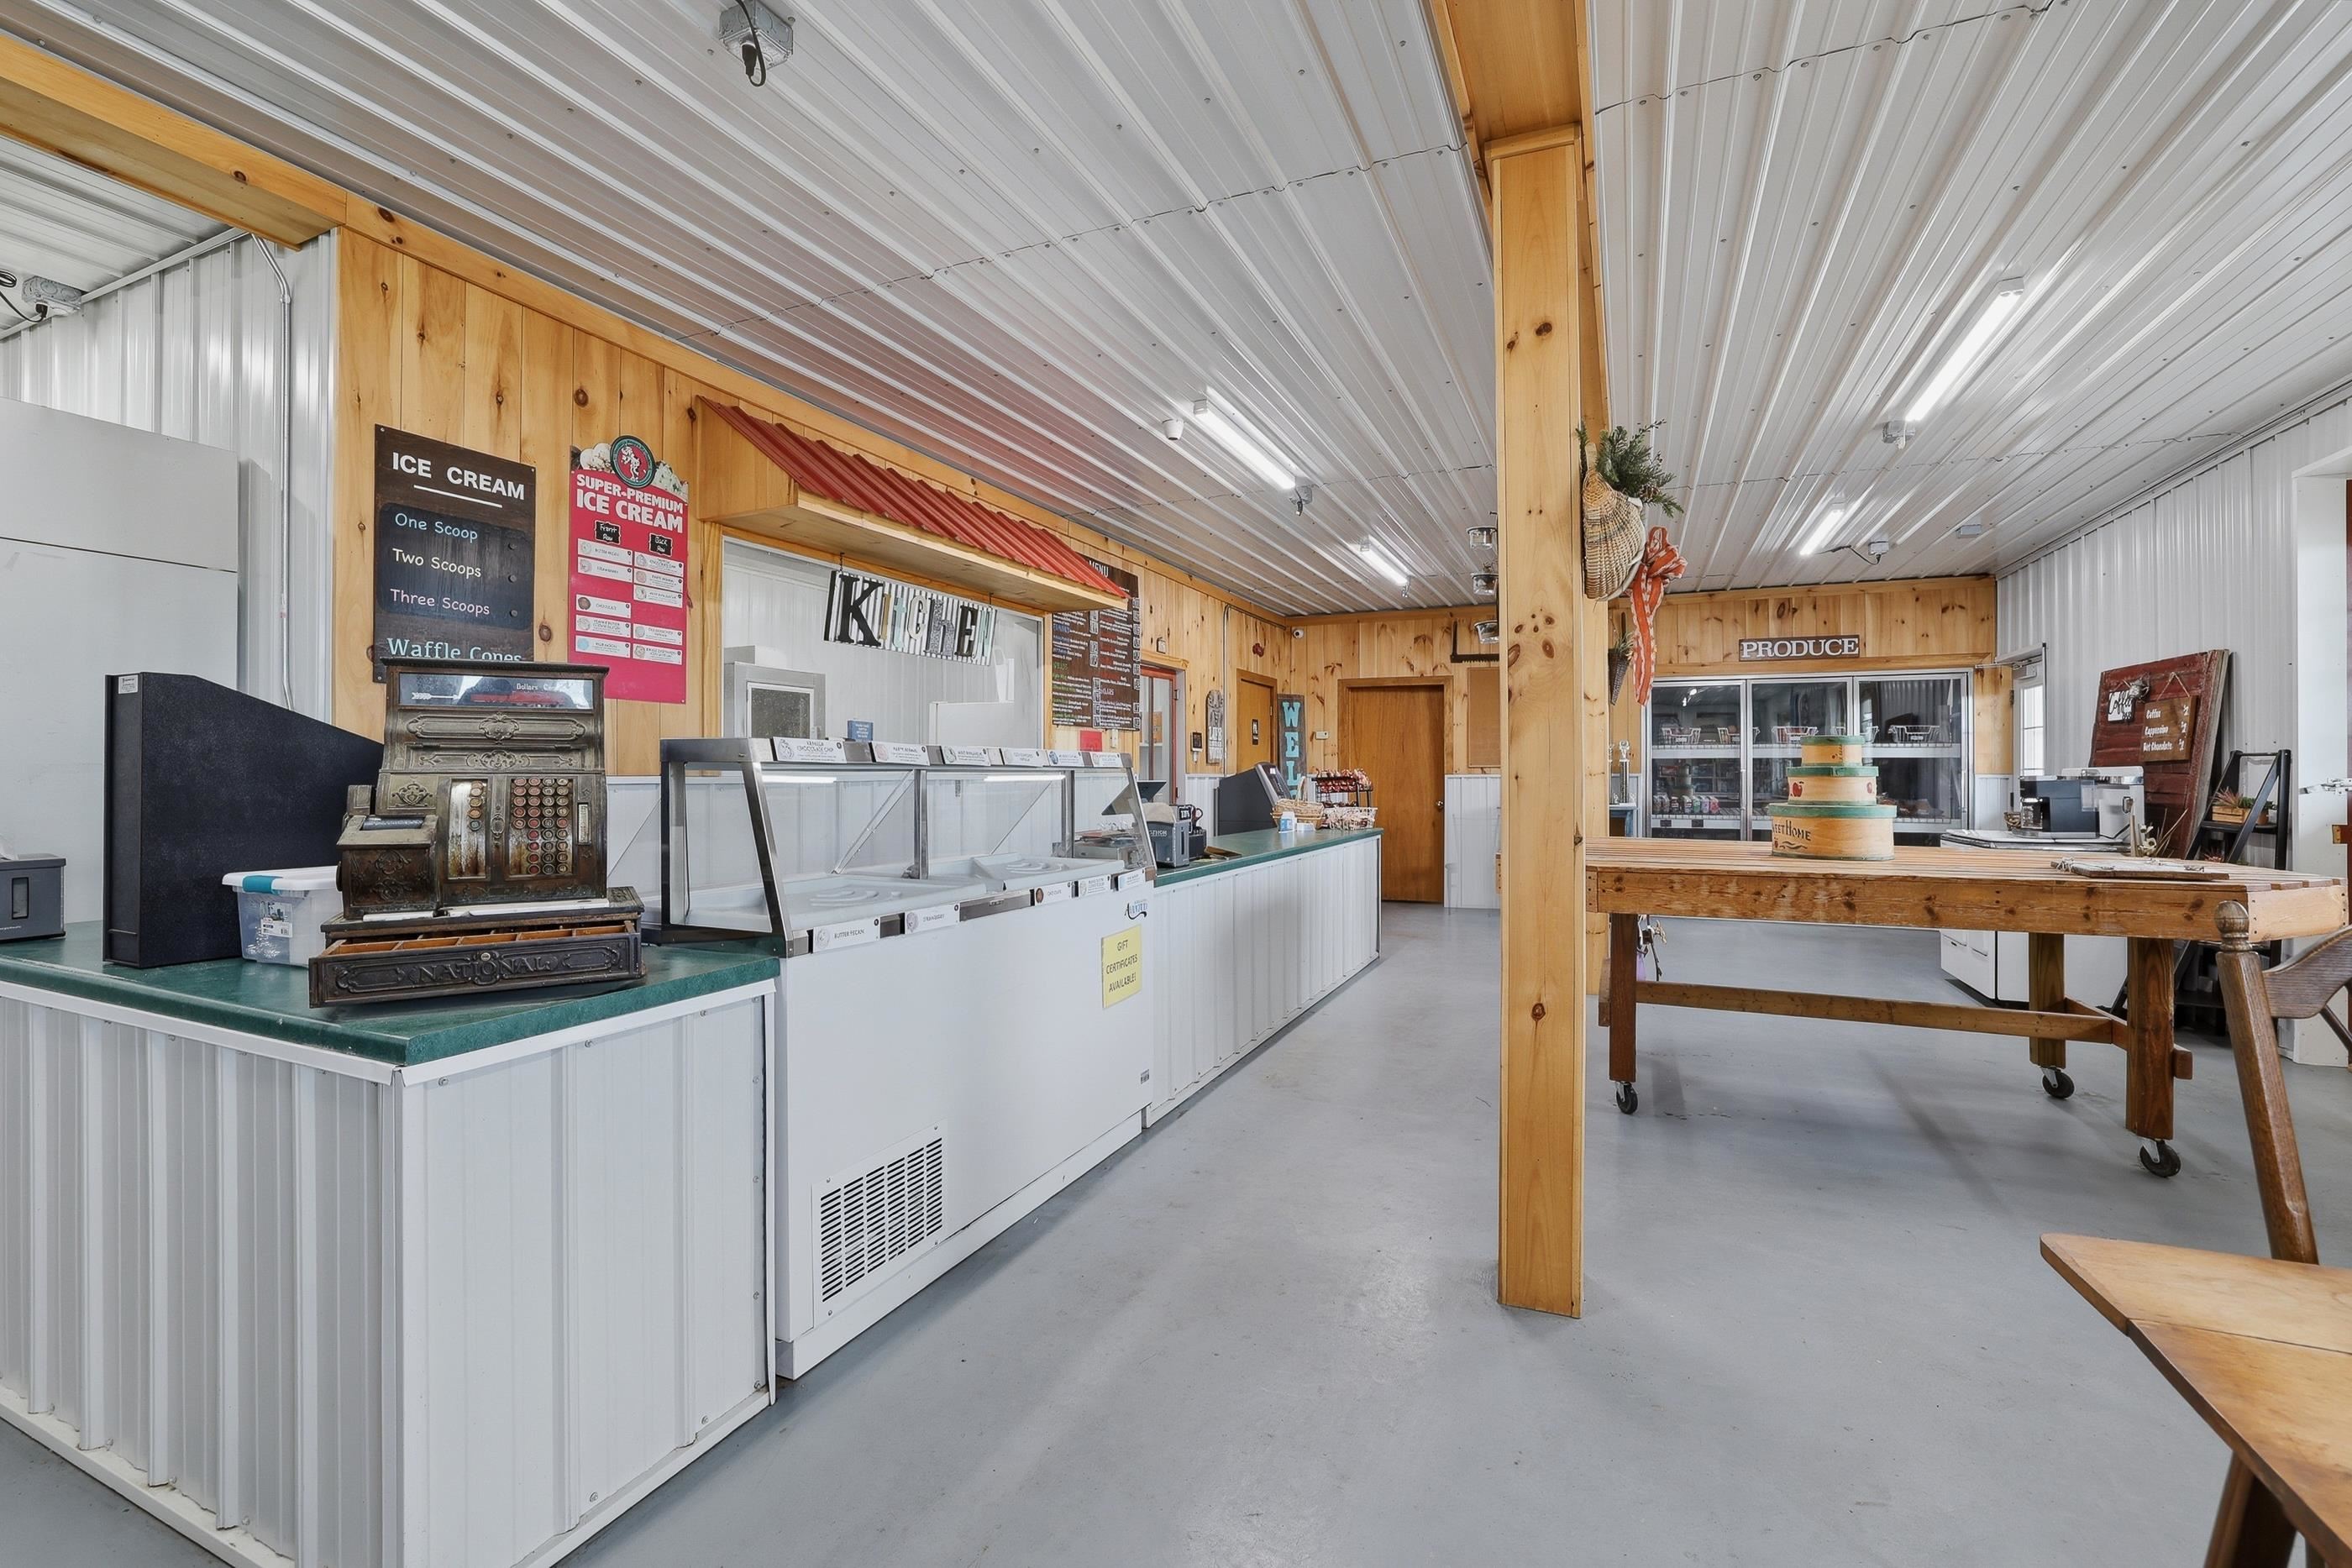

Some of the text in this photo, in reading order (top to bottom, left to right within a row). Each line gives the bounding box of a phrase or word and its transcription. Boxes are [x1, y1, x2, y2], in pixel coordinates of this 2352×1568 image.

[392, 452, 525, 501] ICE CREAM
[576, 474, 684, 514] SUPER-PREMIUM
[576, 488, 683, 533] ICE CREAM
[395, 512, 478, 543] One Scoop
[392, 548, 481, 579] Two Scoops
[390, 588, 491, 616] Three Scoops
[386, 637, 461, 658] Waffle
[1740, 637, 1859, 658] PRODUCE
[2145, 708, 2161, 720] Coffee
[1116, 939, 1129, 952] GIFT
[420, 956, 548, 982] NATIONAL
[1105, 954, 1138, 975] CERTIFICATES
